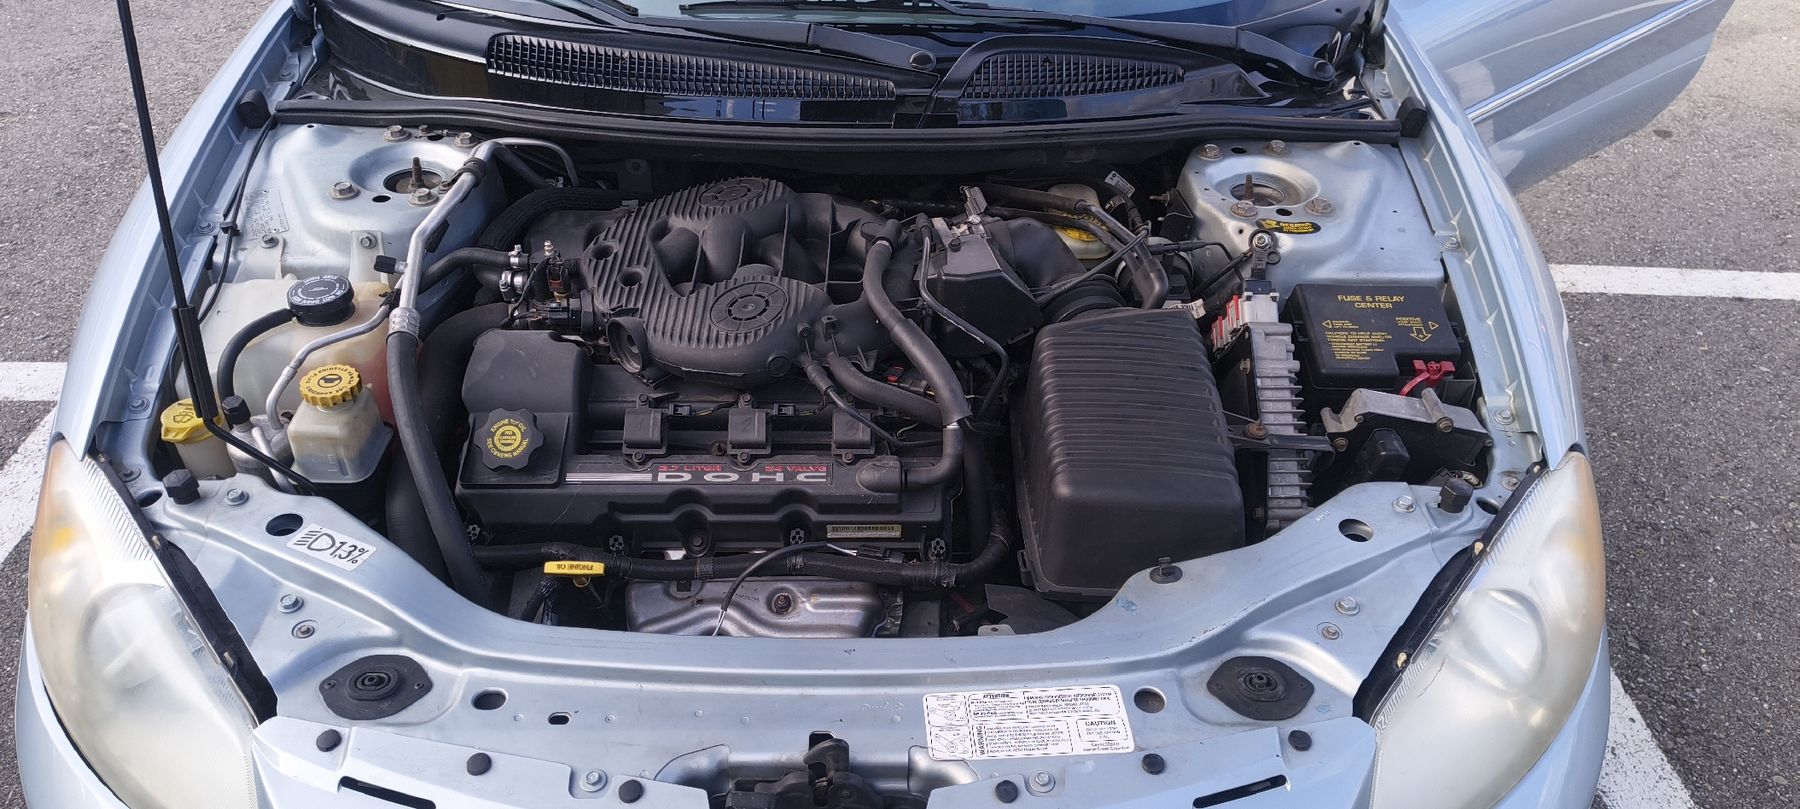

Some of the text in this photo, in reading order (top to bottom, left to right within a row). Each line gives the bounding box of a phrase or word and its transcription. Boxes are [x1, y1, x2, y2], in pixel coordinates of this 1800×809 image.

[1337, 294, 1362, 302] FUSE
[490, 419, 527, 432] ENGINE OIL
[657, 472, 827, 482] DOHC
[976, 725, 986, 756] WARNING
